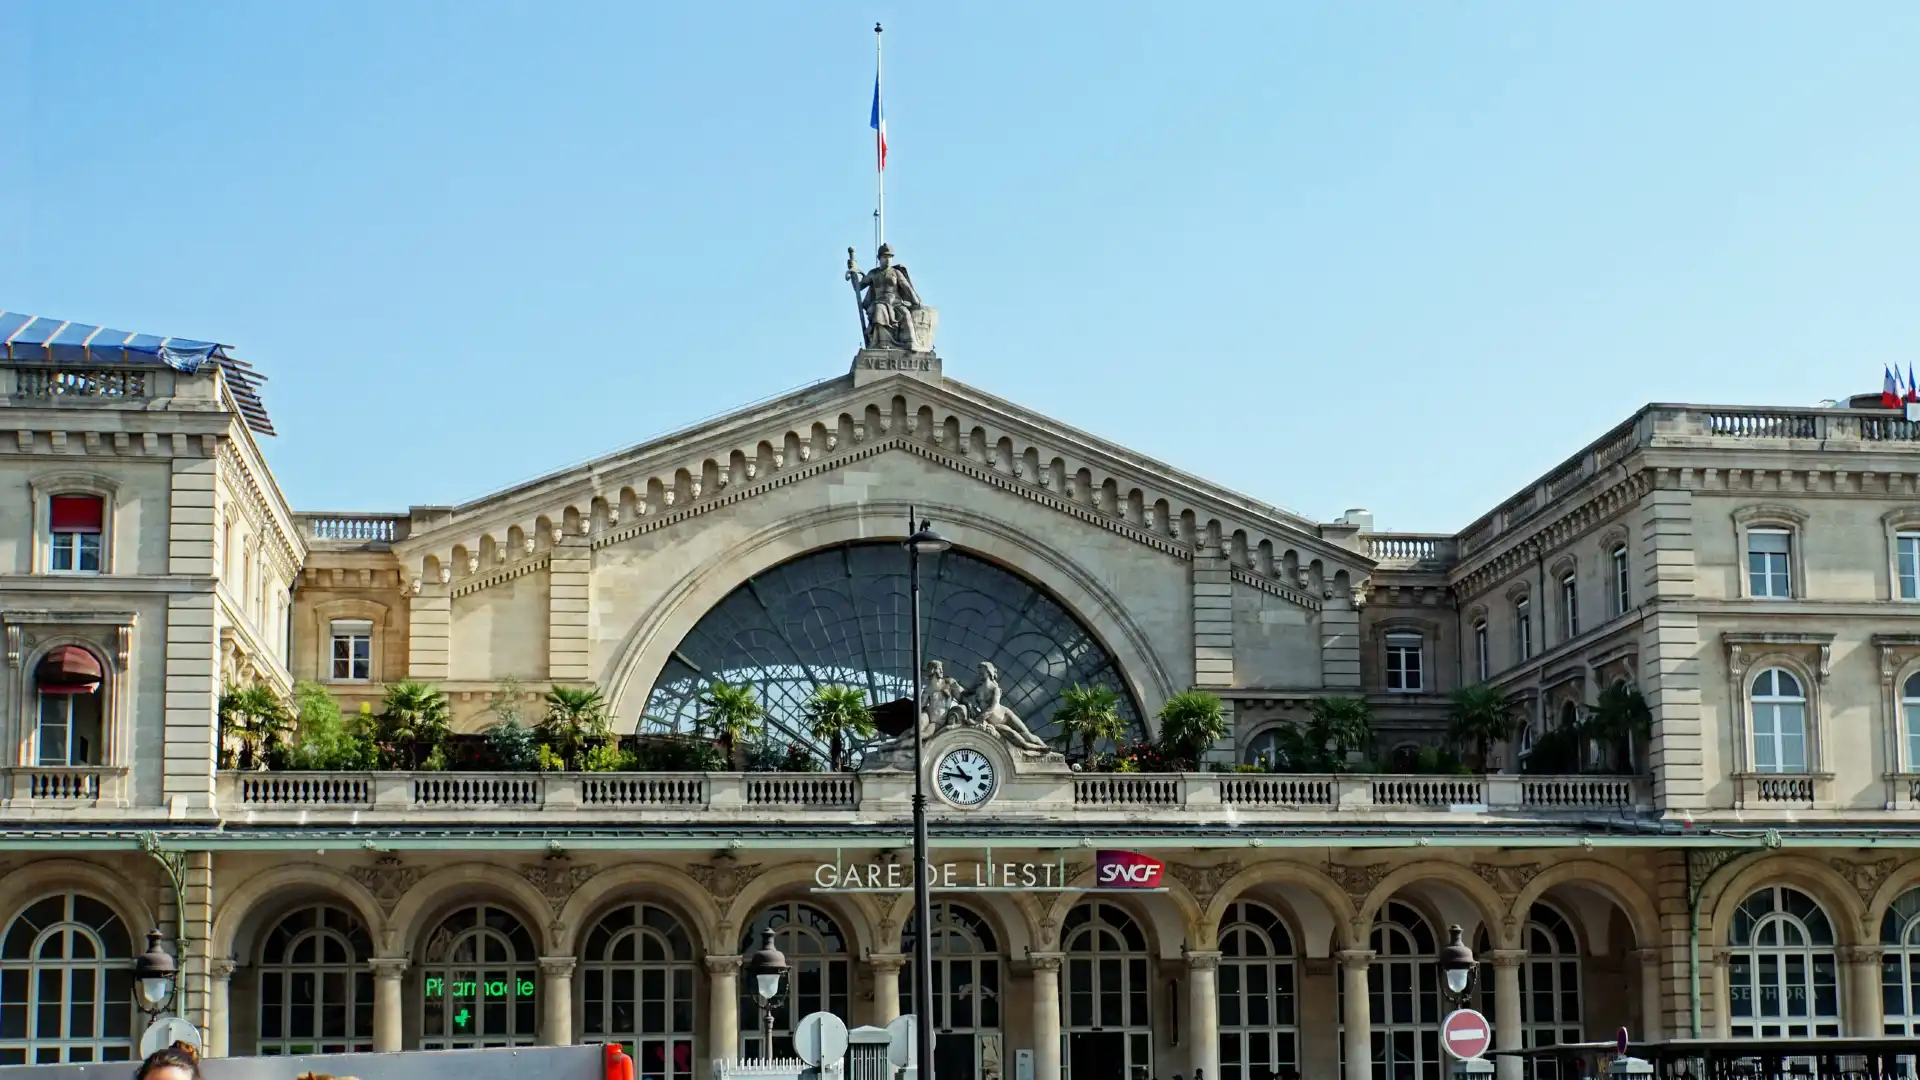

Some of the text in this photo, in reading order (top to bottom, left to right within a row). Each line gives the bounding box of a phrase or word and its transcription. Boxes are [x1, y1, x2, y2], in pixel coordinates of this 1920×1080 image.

[864, 358, 933, 371] VERDUN
[815, 863, 1056, 887] GARE DE L'EST
[1100, 863, 1160, 882] SNCF
[1731, 986, 1819, 1000] SEHOR
